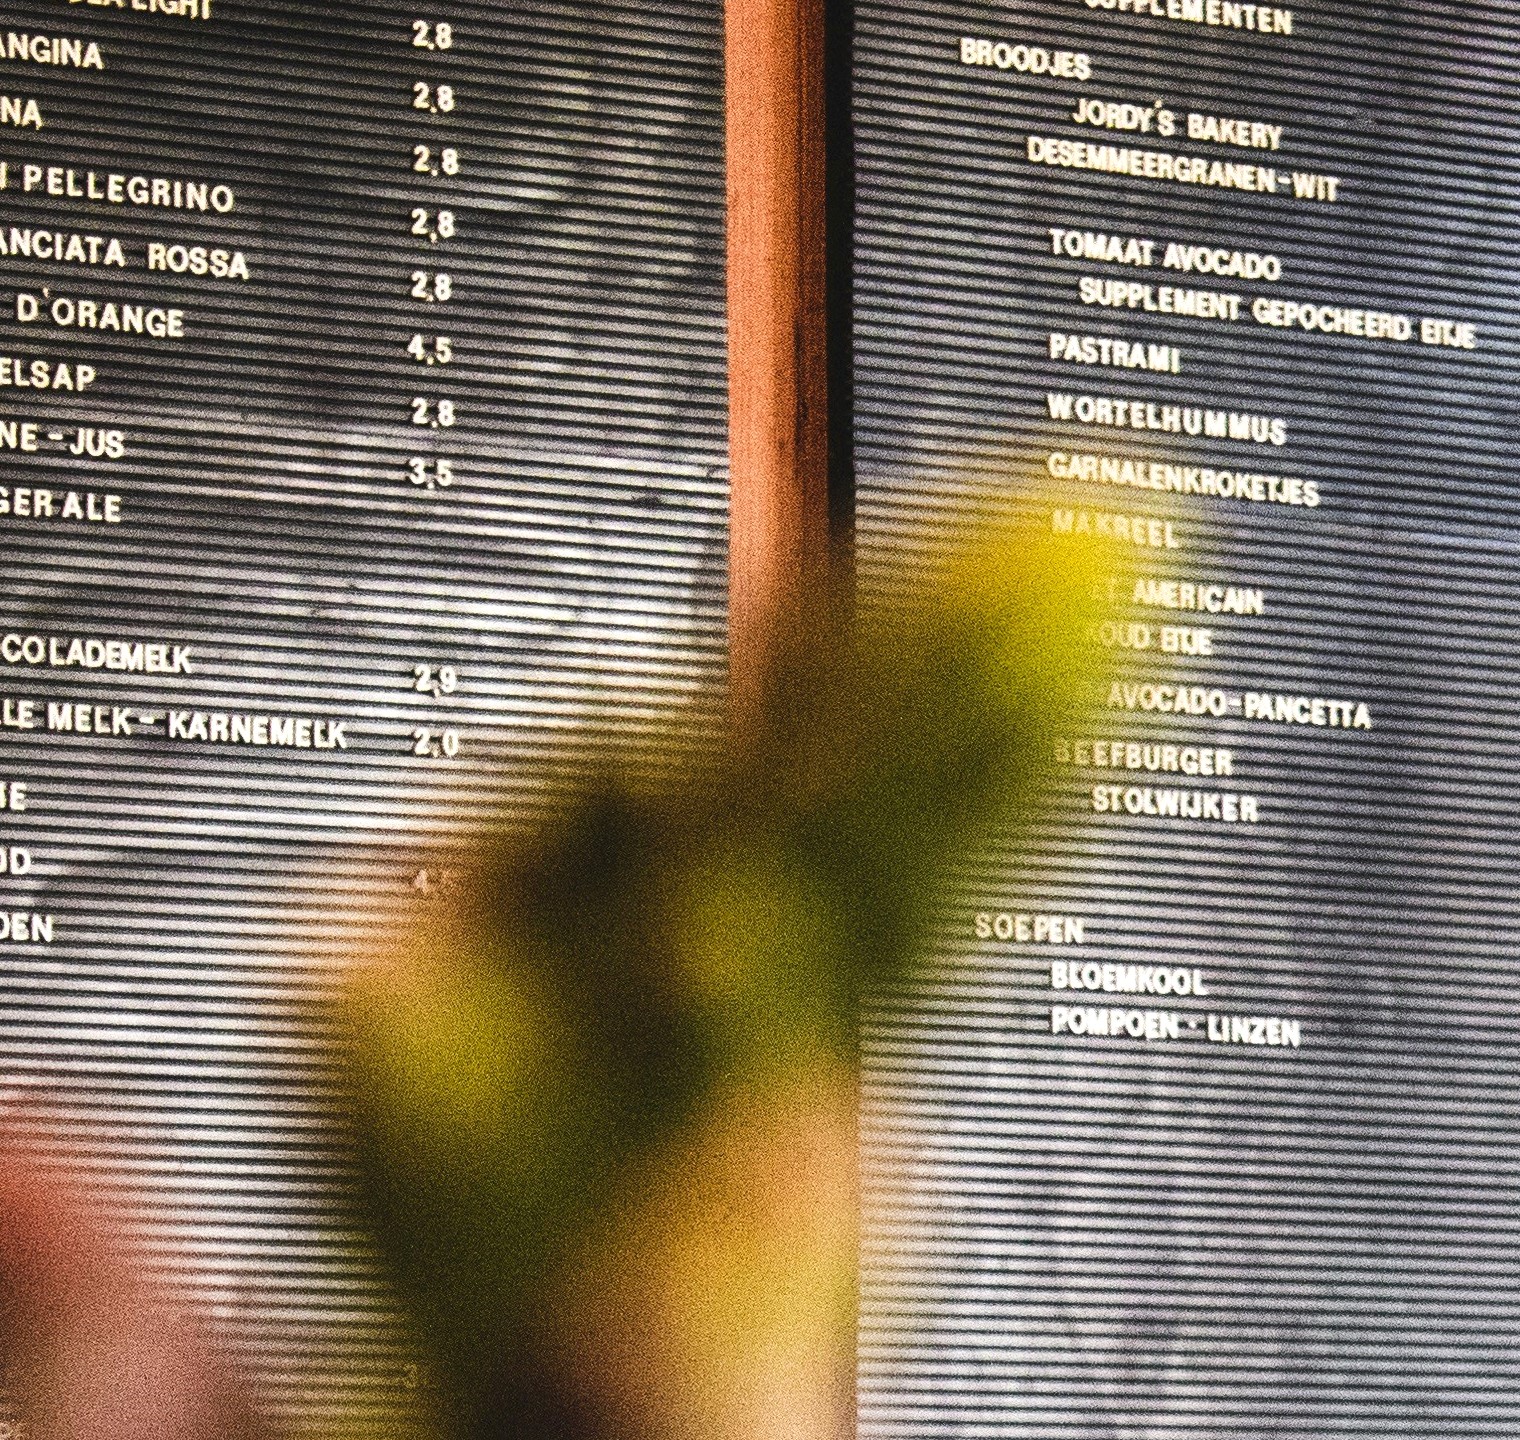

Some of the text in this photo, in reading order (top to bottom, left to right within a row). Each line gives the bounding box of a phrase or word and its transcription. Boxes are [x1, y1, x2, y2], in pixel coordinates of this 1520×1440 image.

[0, 32, 104, 70] NGINA
[960, 38, 1091, 81] BROODJES
[1072, 98, 1282, 150] JORDY'S BAKERY
[23, 164, 235, 213] PELLEGRINO
[148, 243, 250, 280] ROSSA
[1048, 228, 1282, 281] TOMAAT AVOCADO
[16, 287, 185, 338] D'ORANGE
[1078, 277, 1241, 321] SUPPLEMENT
[1252, 298, 1411, 341] GEPOCHEERD
[1048, 333, 1181, 374] PASTRAMI
[1046, 393, 1287, 446] WORTELHUMMUS
[1047, 451, 1321, 507] GARNALENKROKETJES
[1051, 508, 1179, 549] MAKREEL
[1133, 578, 1265, 616] AMERICAIN
[47, 702, 131, 735] MELK
[168, 712, 347, 749] KARNEMELK
[1055, 739, 1233, 777] BEEFBURGER
[1092, 786, 1259, 823] STOLWIJKER
[973, 913, 1084, 944] SOEPEN
[1051, 960, 1208, 997] BLOEMKOOL
[1051, 1005, 1300, 1050] POMPOEN LINZEN
